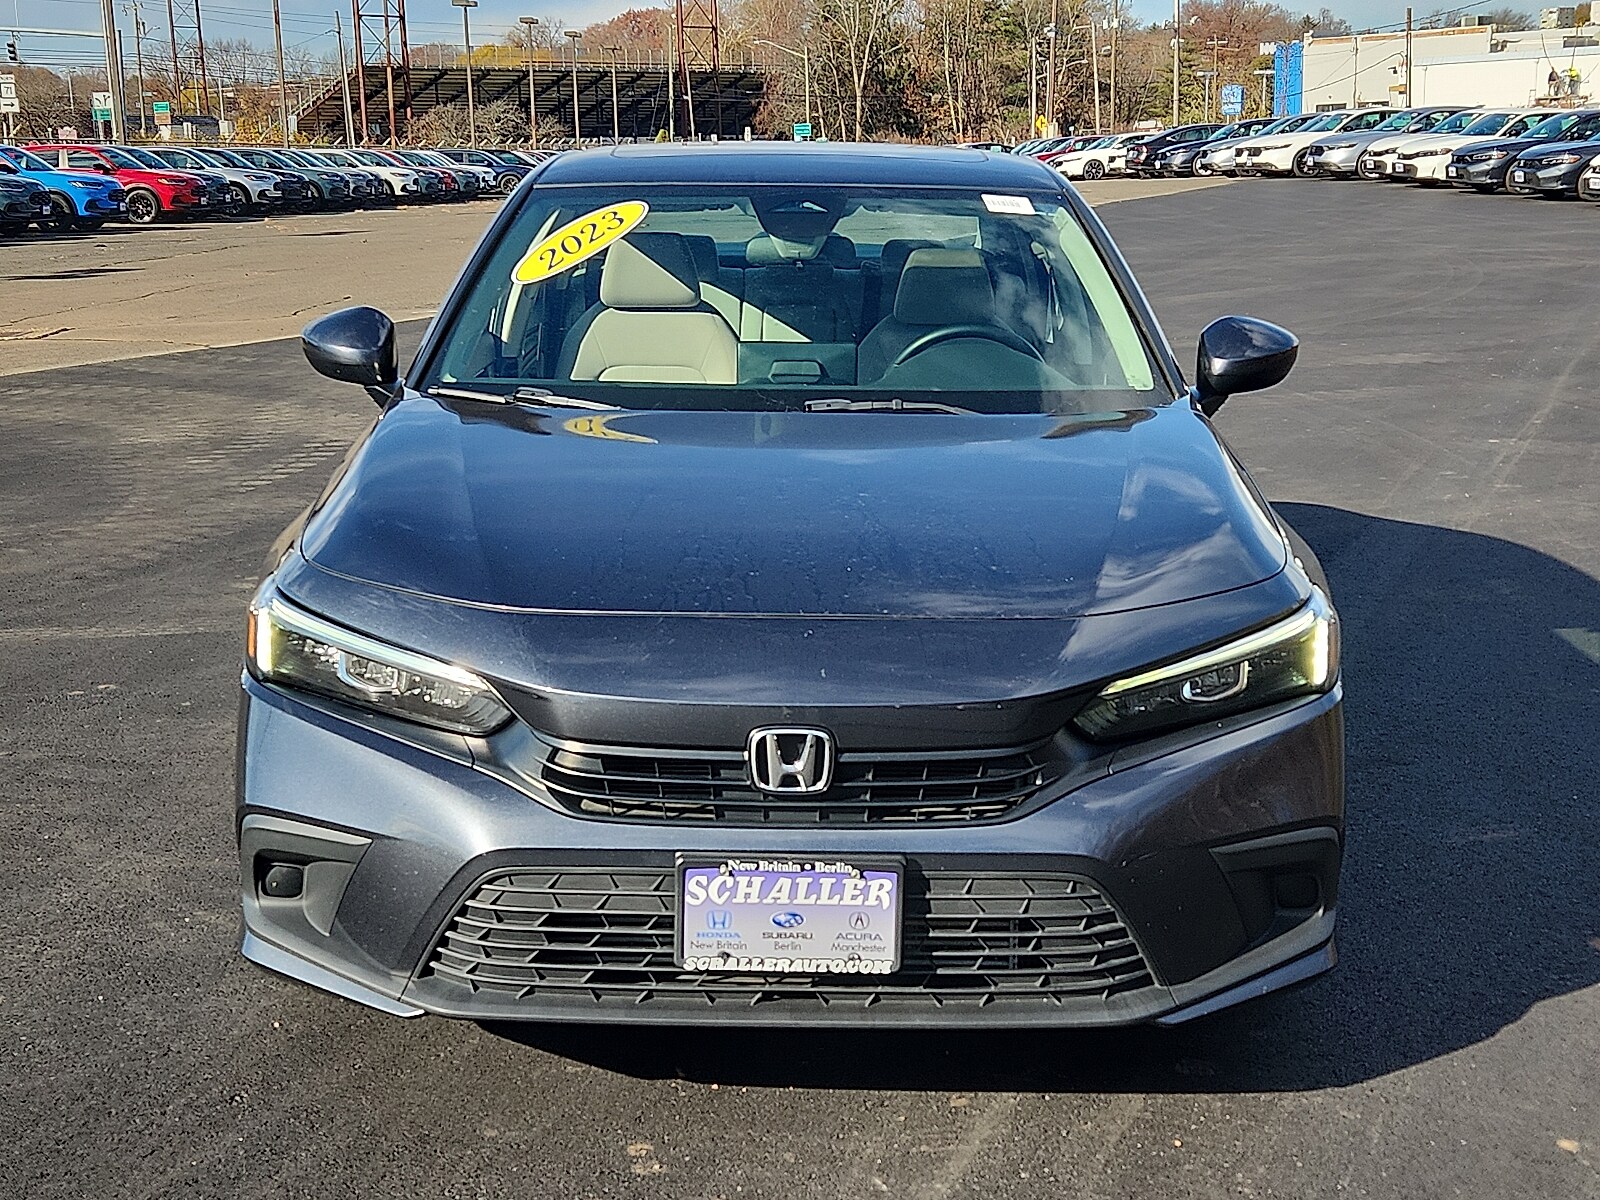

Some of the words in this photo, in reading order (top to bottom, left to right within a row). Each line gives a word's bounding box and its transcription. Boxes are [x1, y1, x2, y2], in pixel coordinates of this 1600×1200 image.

[4, 86, 13, 95] 71
[539, 210, 625, 271] 2023
[727, 860, 758, 871] New
[758, 860, 801, 873] Britain
[814, 861, 854, 874] Berlin
[685, 874, 894, 910] SCHALLER
[762, 932, 814, 940] SUBARU
[835, 932, 883, 941] ACURA
[690, 940, 714, 950] New
[716, 939, 748, 951] Britain
[773, 939, 802, 951] Berlin
[830, 940, 888, 953] Manchester
[683, 956, 894, 975] SCHALLERAUTO.COM
